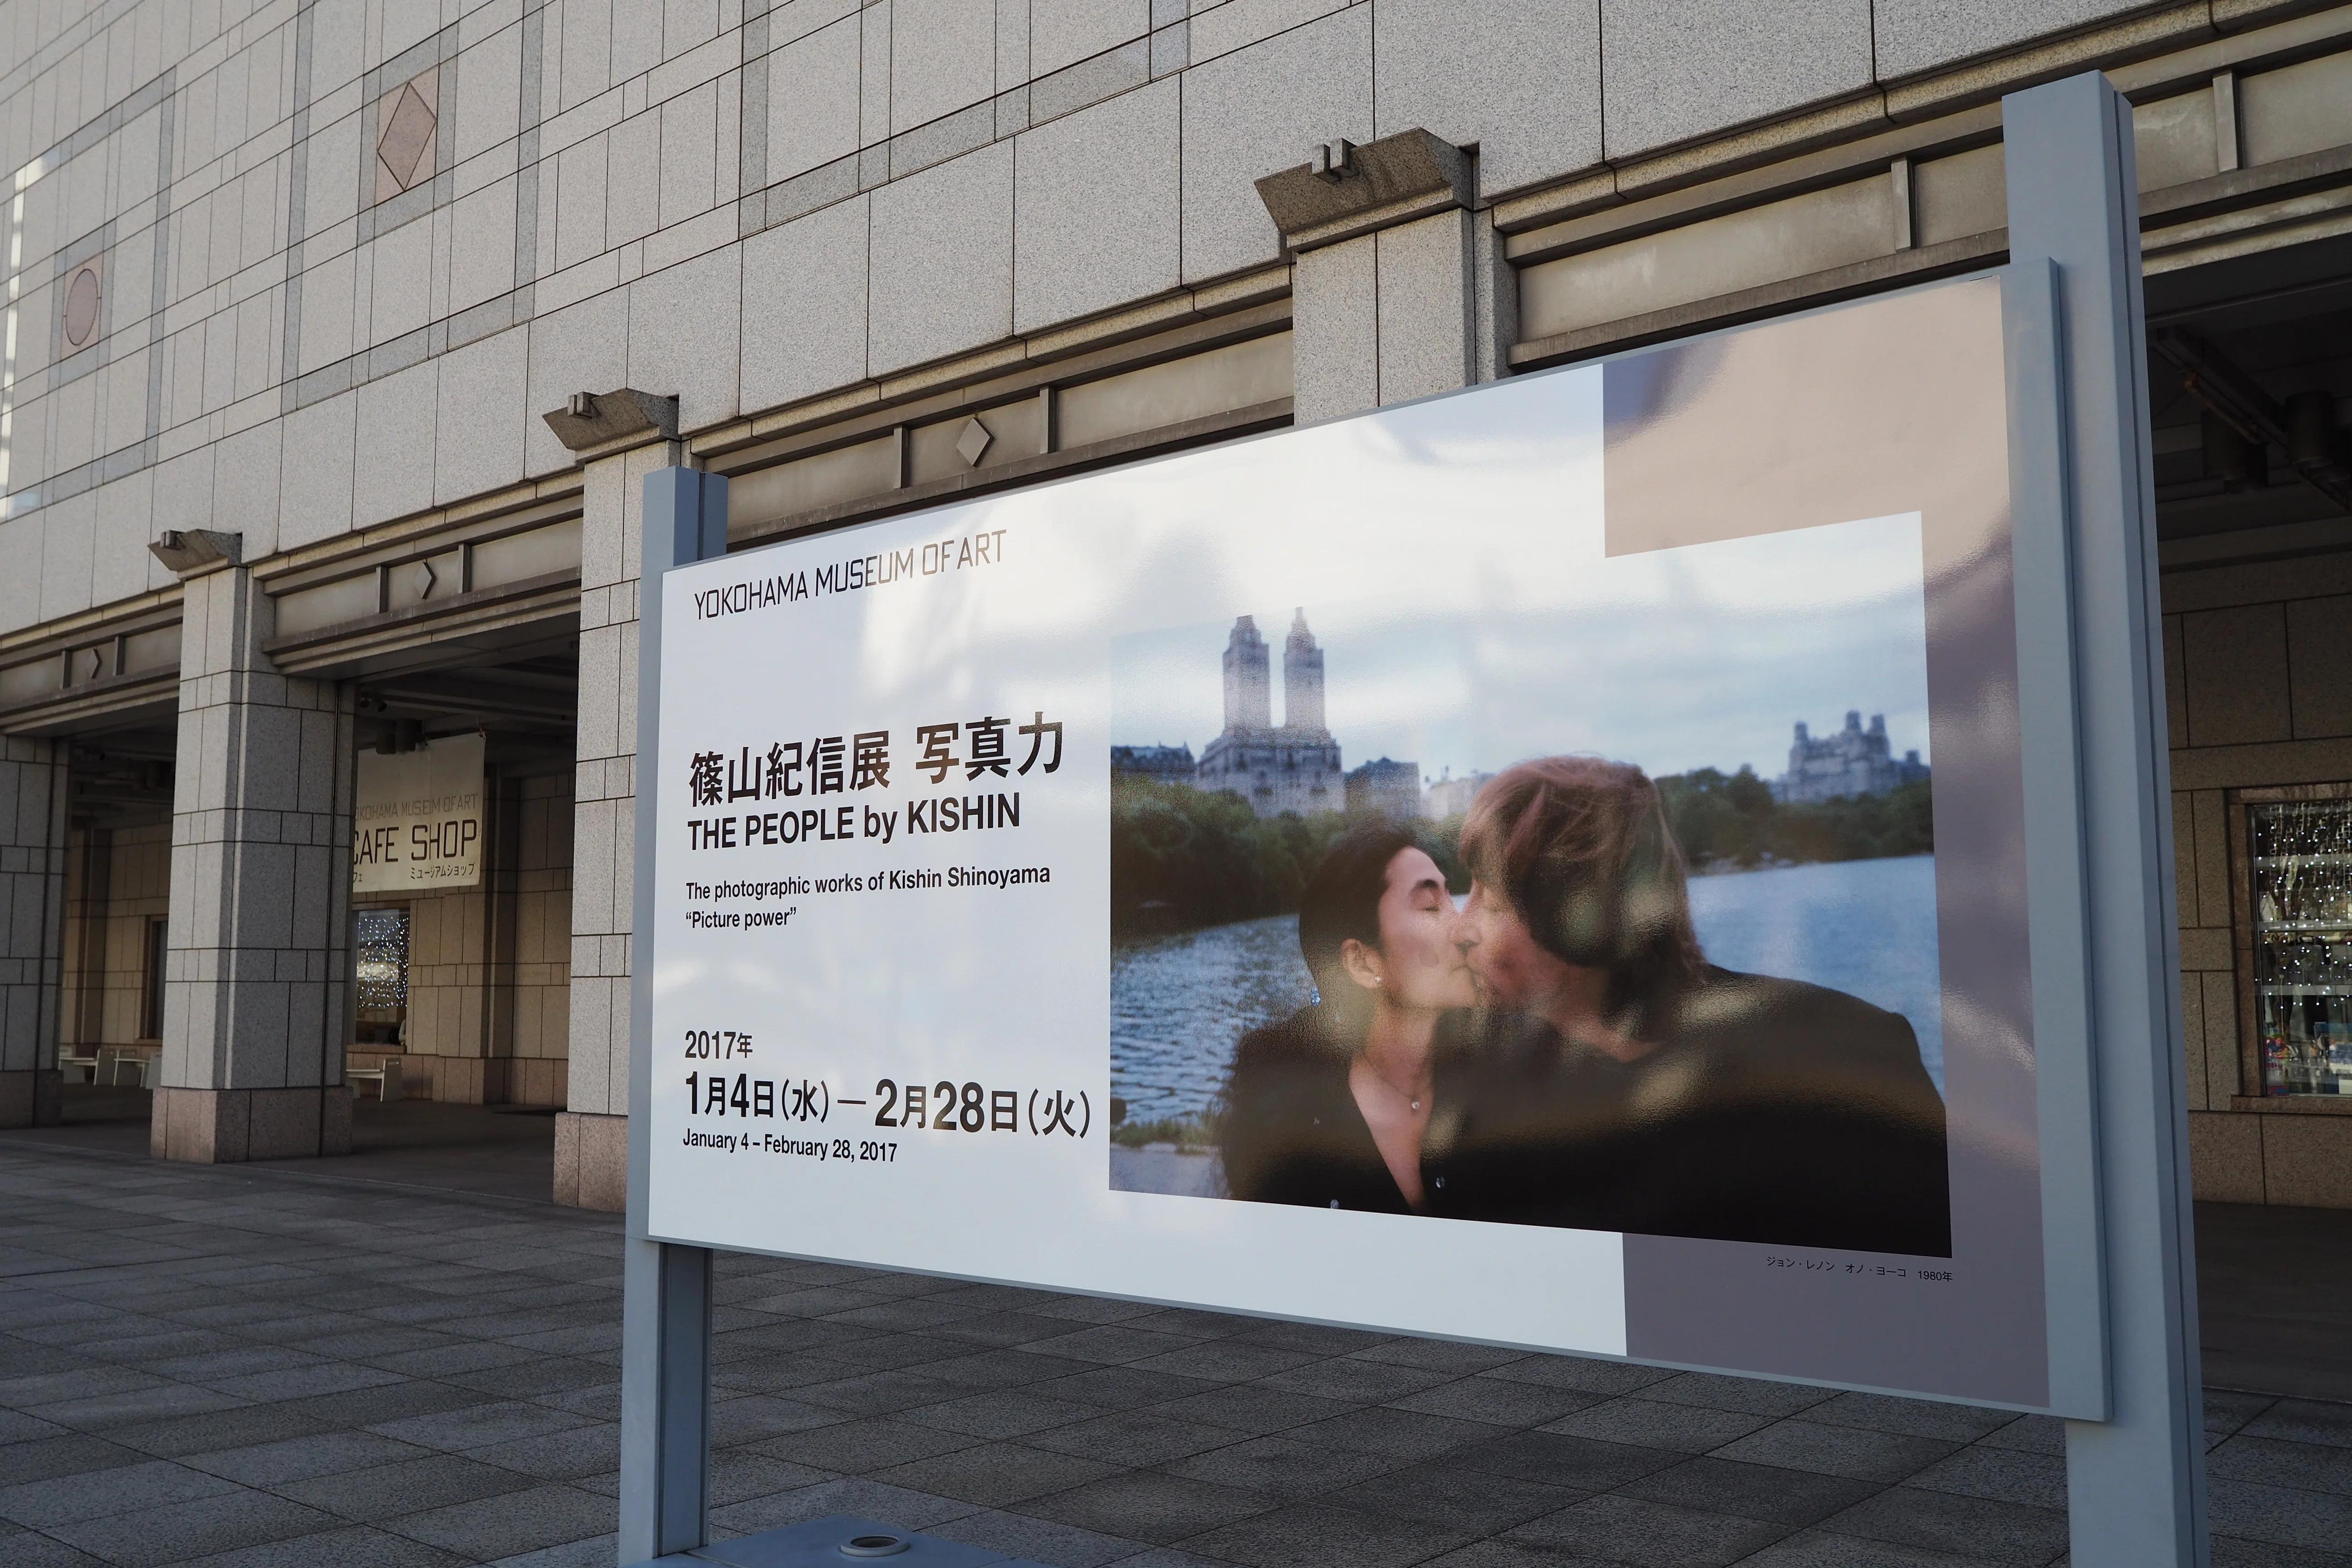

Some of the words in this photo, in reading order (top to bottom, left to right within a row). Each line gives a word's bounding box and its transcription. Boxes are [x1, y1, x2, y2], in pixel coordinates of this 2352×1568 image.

[694, 571, 808, 620] YOKOHAMA
[816, 548, 914, 597] MUSEUM
[689, 730, 890, 807] 篠山紀信展
[916, 711, 1063, 784] 写真力
[688, 817, 736, 851] THE
[745, 806, 854, 847] PEOPLE
[864, 804, 898, 844] by
[908, 792, 1019, 834] KISHIN
[411, 819, 477, 861] SHOP
[411, 861, 475, 879] ミュージアムショップ
[686, 882, 710, 900] The
[715, 877, 810, 903] photographic
[815, 873, 863, 893] works
[868, 871, 885, 891] of
[889, 869, 942, 890] Kishin
[947, 867, 1050, 889] Shinoyama
[686, 911, 740, 929] “Picture
[745, 906, 797, 931] power”
[685, 1030, 753, 1059] 2017年
[683, 1128, 737, 1153] January
[740, 1132, 749, 1151] 4
[764, 1134, 828, 1161] February
[832, 1139, 855, 1163] 28,
[859, 1141, 897, 1162] 2017
[1766, 1256, 1835, 1271] ジョン・レノン
[1845, 1263, 1906, 1278] オノ・ヨーコ
[1917, 1270, 1953, 1282] 1980年
